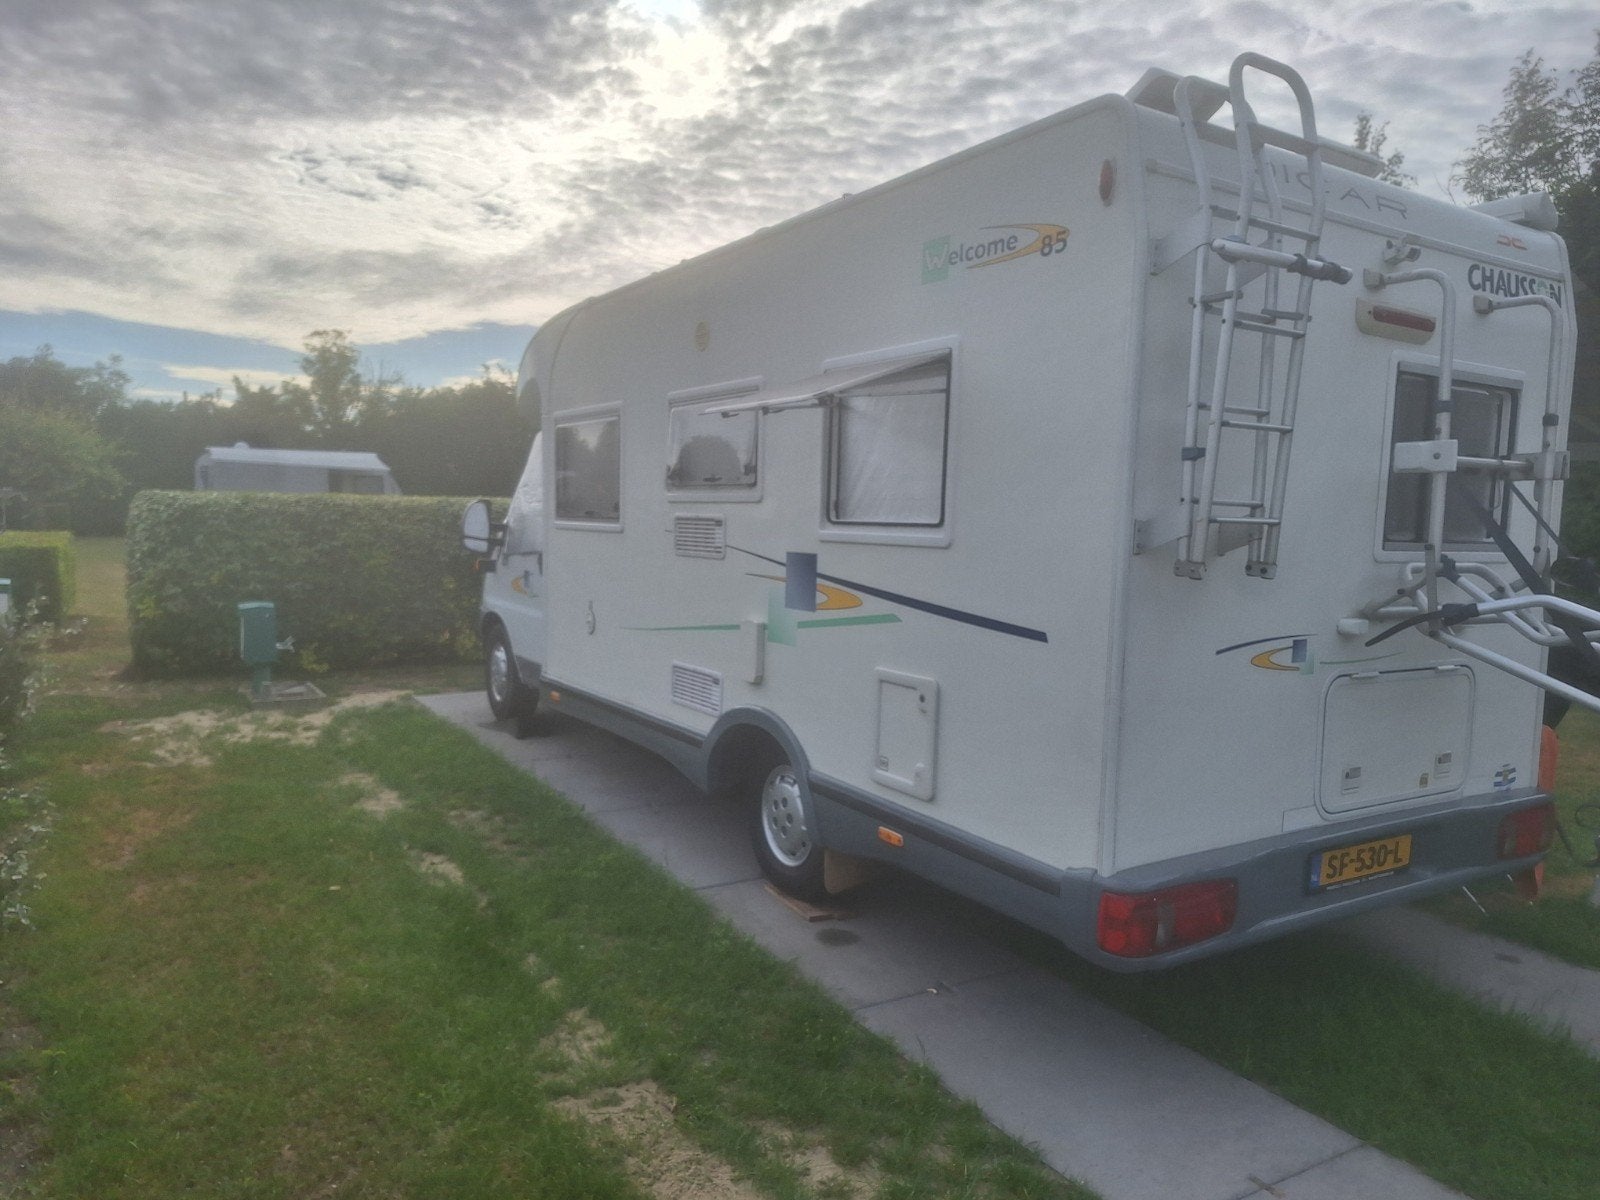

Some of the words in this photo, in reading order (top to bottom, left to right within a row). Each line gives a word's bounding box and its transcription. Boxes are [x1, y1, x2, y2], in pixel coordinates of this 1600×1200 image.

[924, 234, 1018, 272] Welcome
[1040, 229, 1068, 257] 85
[1325, 840, 1403, 879] SF-530-L
